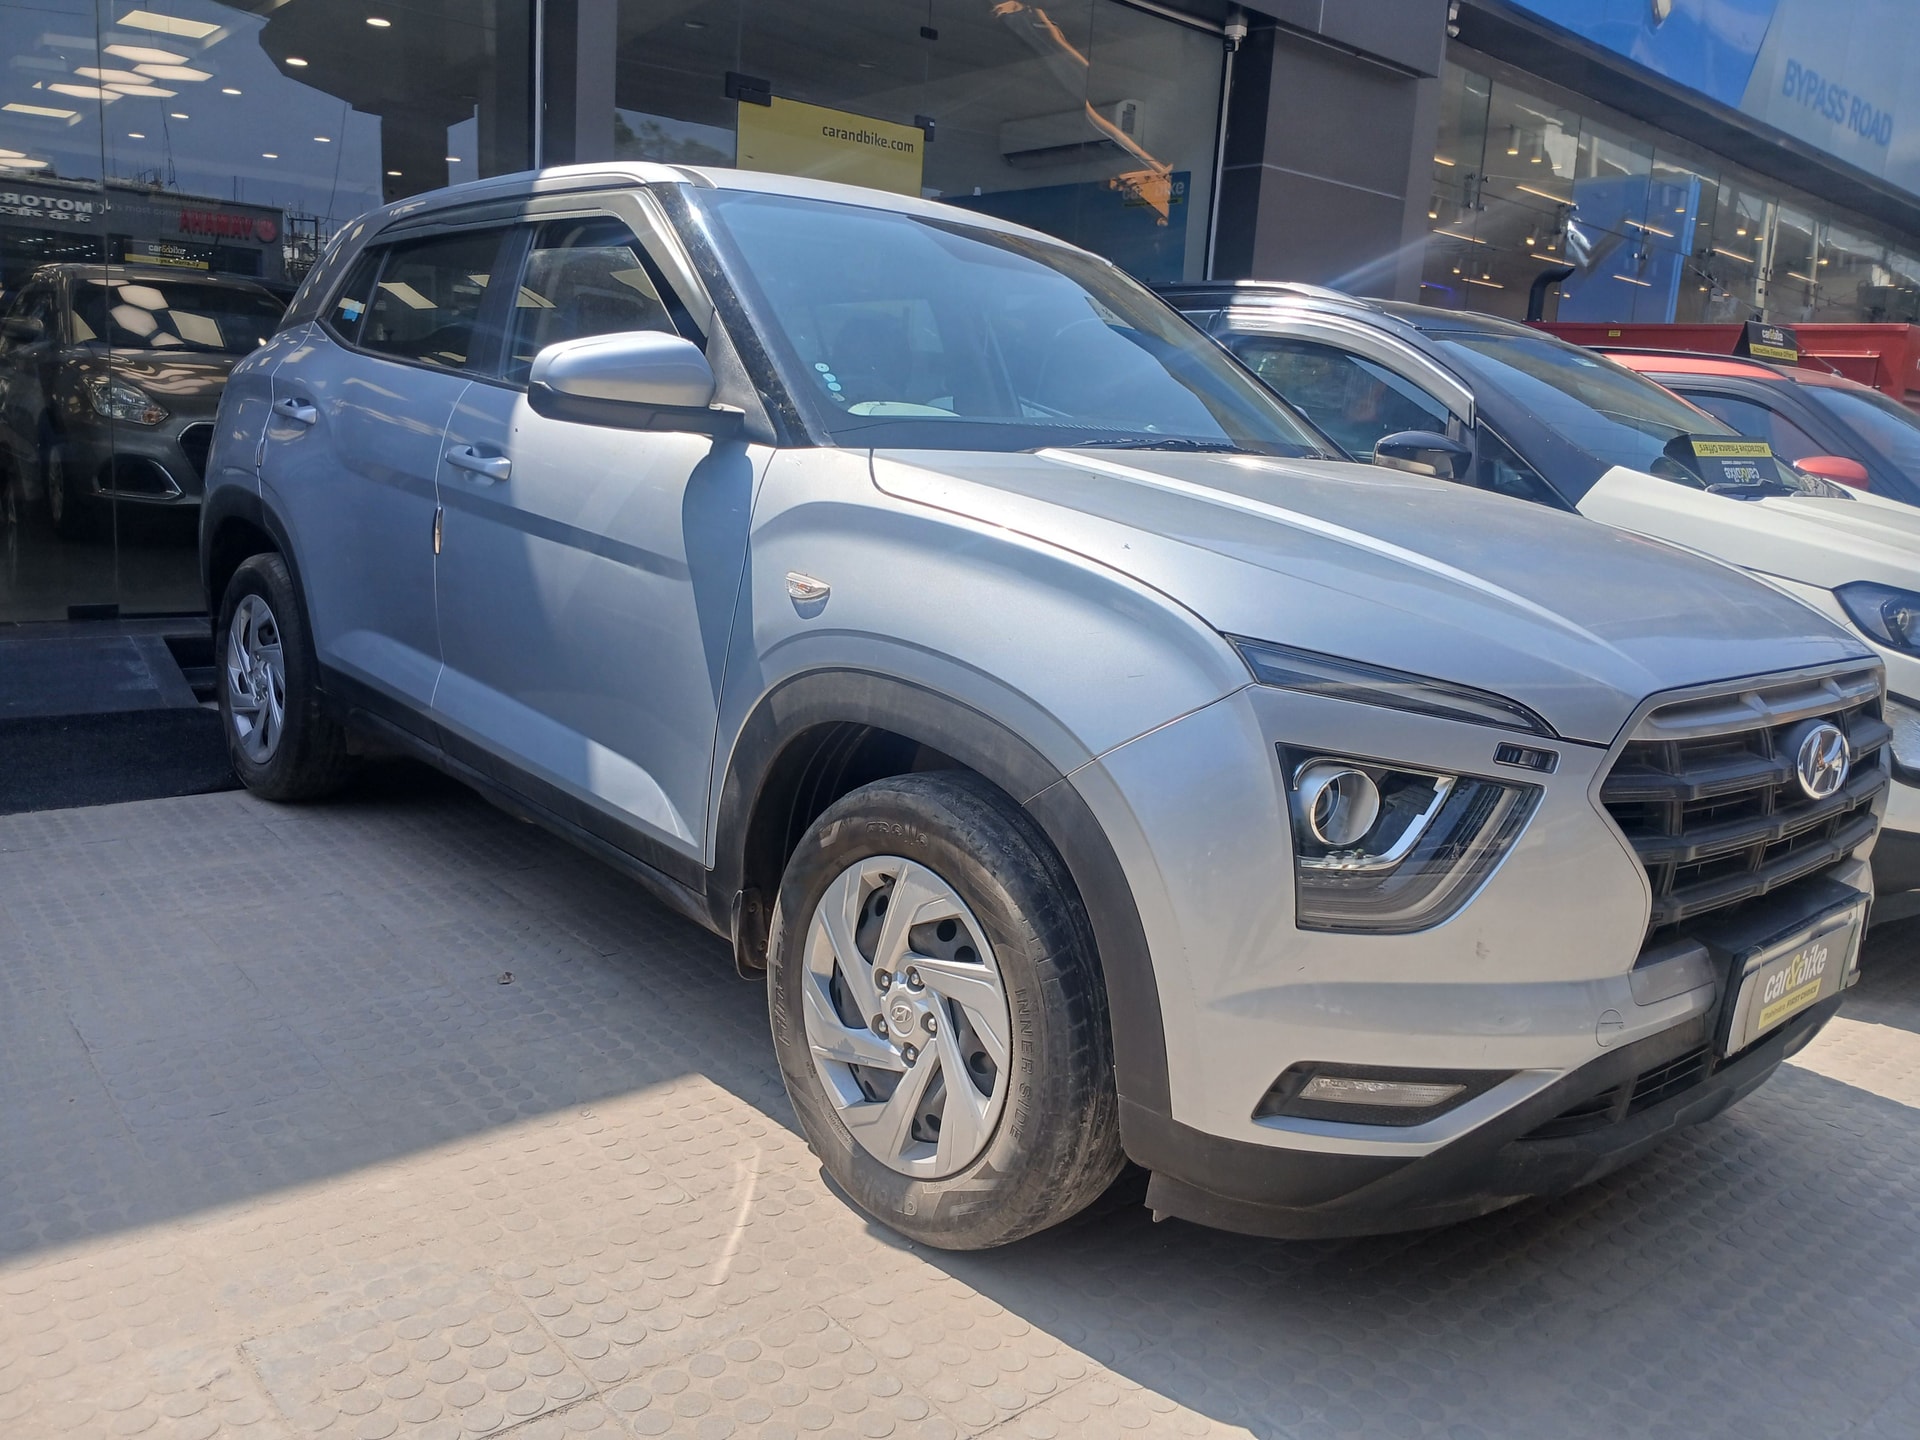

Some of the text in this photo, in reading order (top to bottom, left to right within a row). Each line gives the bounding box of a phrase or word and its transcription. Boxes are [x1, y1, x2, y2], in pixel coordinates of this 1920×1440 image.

[1782, 58, 1894, 146] BYPASS ROAD
[822, 125, 914, 154] carandbike.com
[1764, 944, 1828, 1004] car&bike
[1010, 987, 1034, 1142] INNER SIDE
